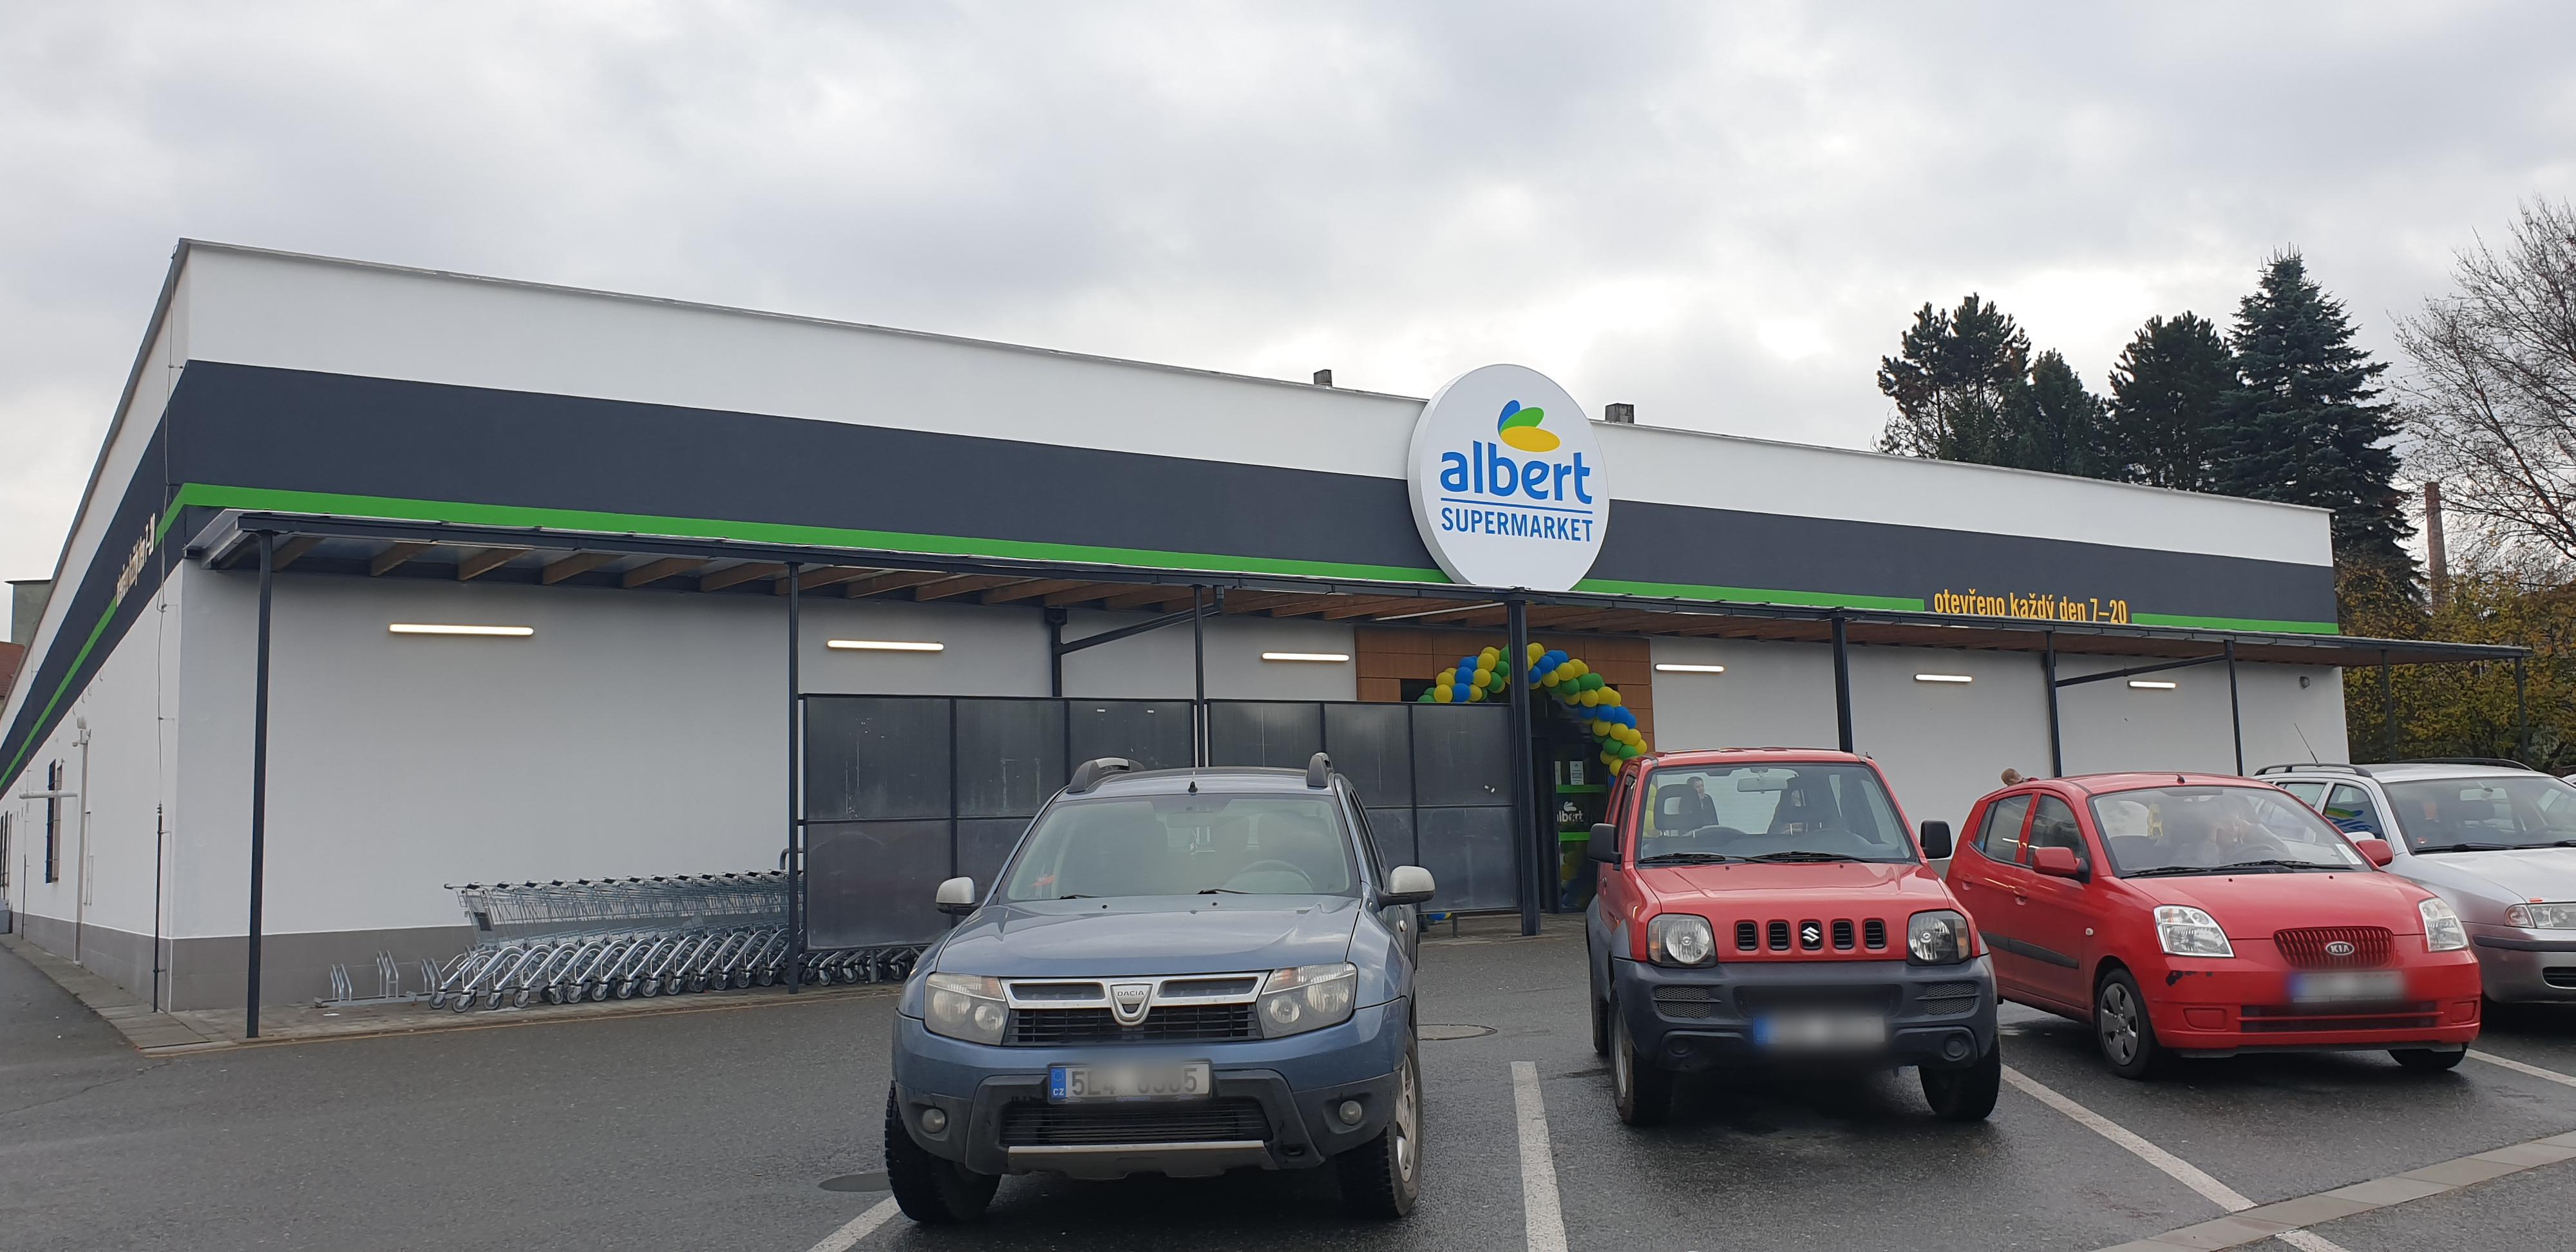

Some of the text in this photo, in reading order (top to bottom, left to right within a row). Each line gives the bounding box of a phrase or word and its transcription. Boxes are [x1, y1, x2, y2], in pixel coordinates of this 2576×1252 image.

[1440, 440, 1593, 504] albert
[1441, 507, 1593, 542] SUPERMARKET
[1934, 589, 2005, 616] otevřeno
[2010, 592, 2055, 619] každý
[2060, 596, 2086, 621] den
